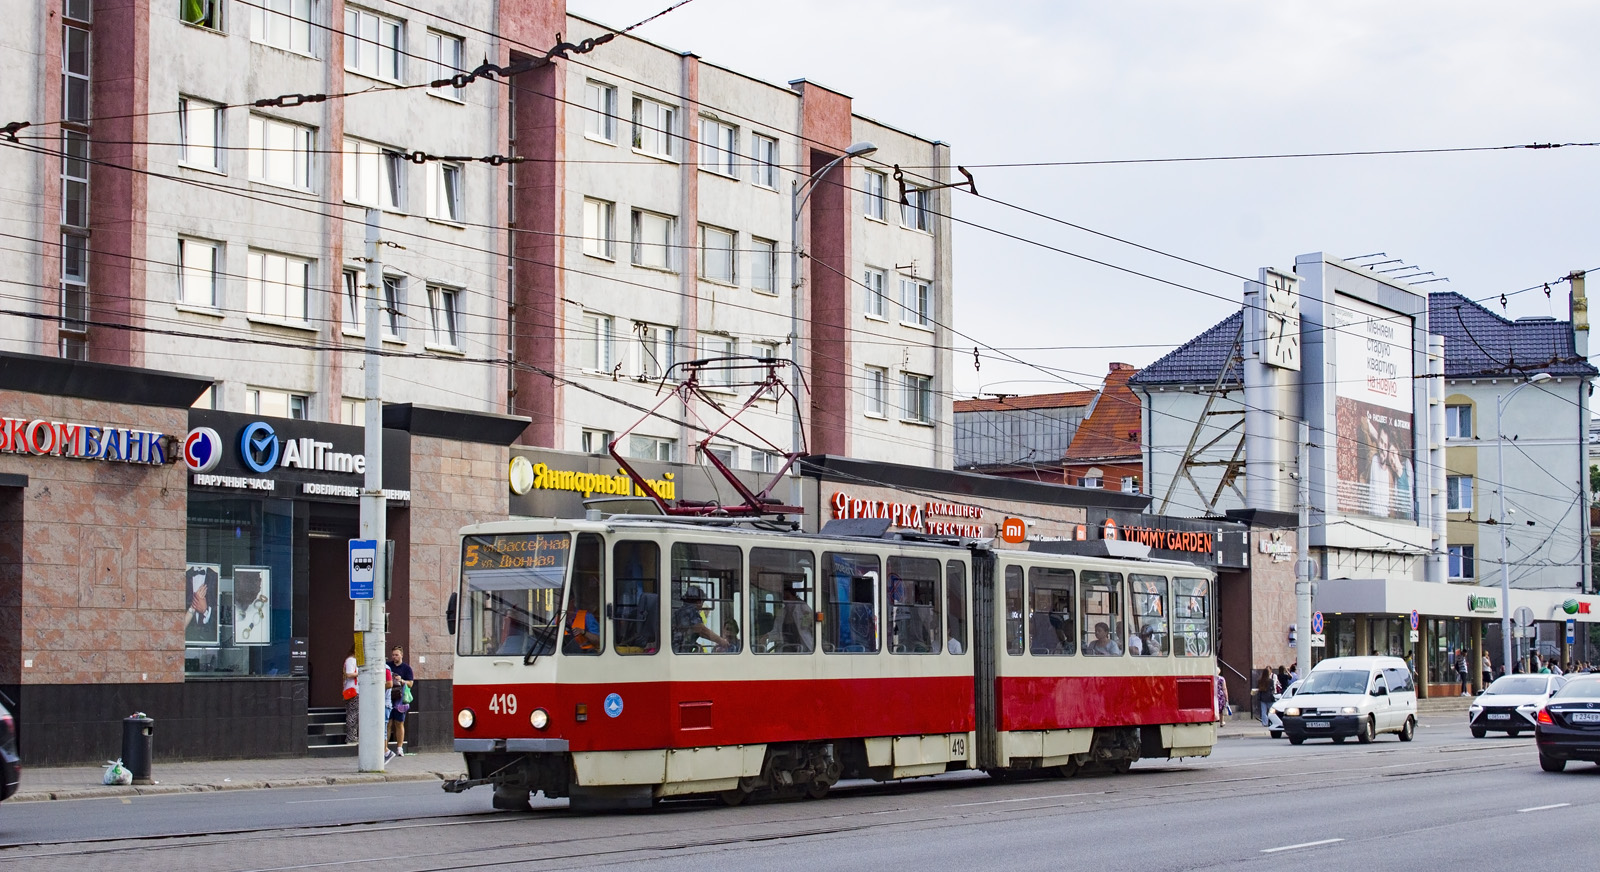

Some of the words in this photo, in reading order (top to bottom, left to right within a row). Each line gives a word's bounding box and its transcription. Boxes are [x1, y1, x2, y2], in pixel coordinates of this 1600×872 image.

[1367, 317, 1394, 340] Меняем
[1367, 338, 1391, 358] старую
[1367, 356, 1398, 378] квартиру
[1367, 374, 1376, 390] на
[1376, 376, 1398, 396] новую
[281, 437, 366, 474] AllTime
[194, 474, 247, 488] НАРУЧНЫЕ
[248, 477, 275, 491] ЧАСЫ
[303, 482, 359, 497] ЮВЕЛИРНЫЕ
[533, 462, 631, 498] Янтарный
[926, 521, 984, 539] ТЕКСТИЛЯ
[1122, 525, 1165, 549] YUMMY
[1166, 529, 1213, 553] GARDEN
[497, 536, 570, 552] Бассейная
[465, 545, 479, 566] 5
[499, 554, 555, 568] Дюнная
[489, 693, 517, 714] 419
[952, 739, 965, 756] 419
